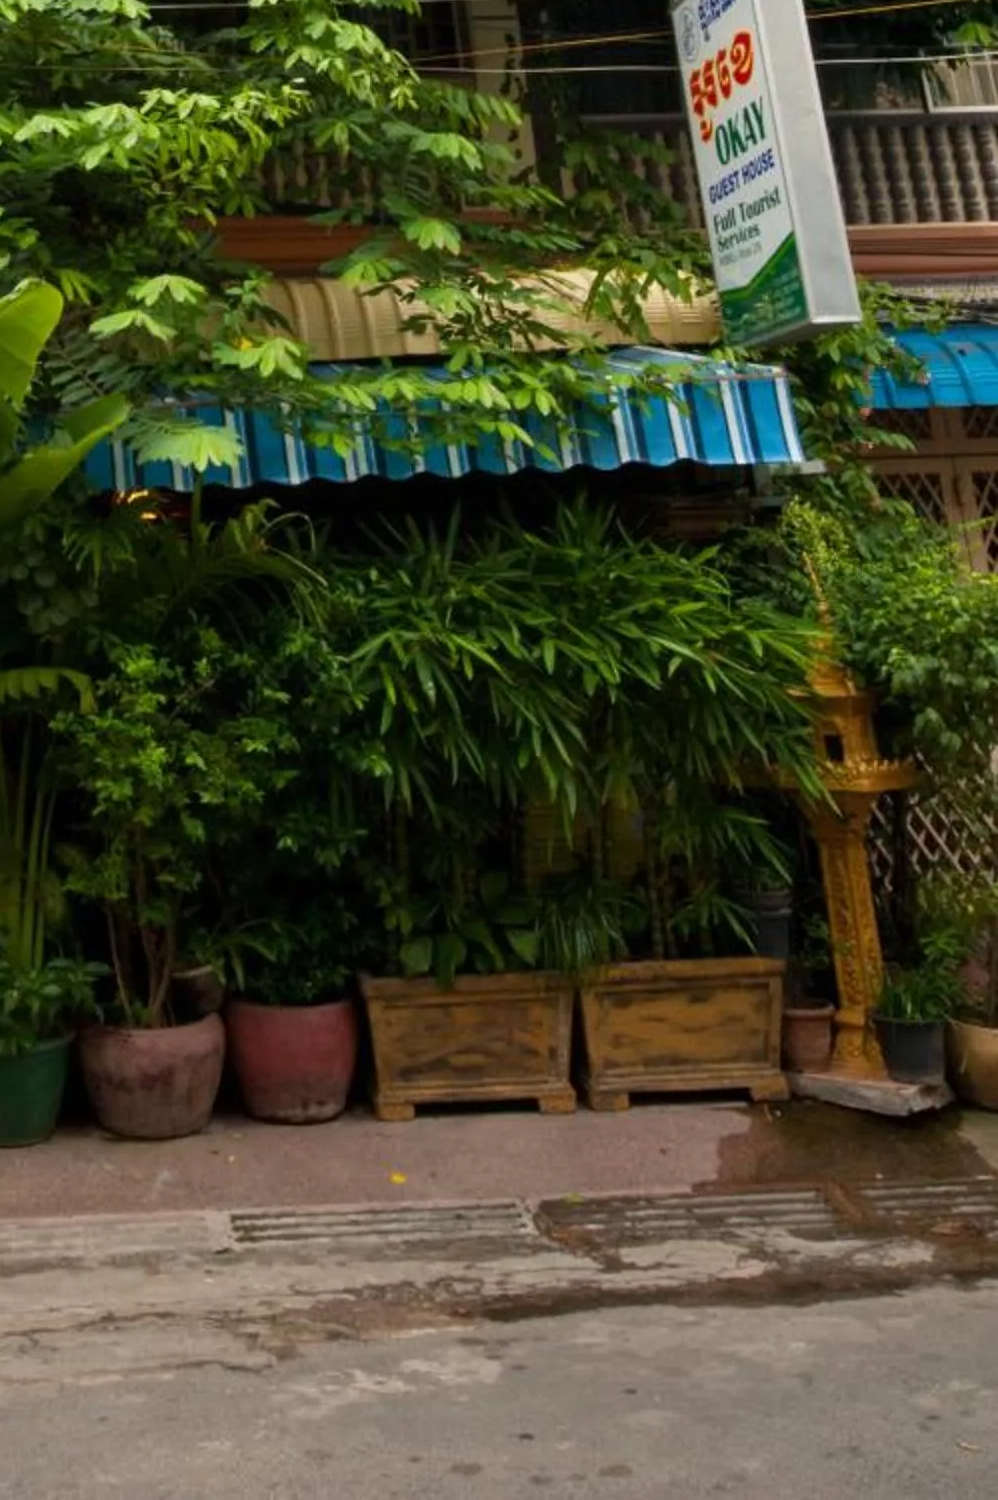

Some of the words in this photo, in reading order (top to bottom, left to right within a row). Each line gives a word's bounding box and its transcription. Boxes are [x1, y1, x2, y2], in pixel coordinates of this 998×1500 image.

[715, 95, 765, 165] OKAY
[709, 170, 740, 204] GUEST
[741, 148, 775, 185] HOUSE
[713, 207, 736, 234] Full
[738, 186, 781, 221] Tourist
[717, 223, 760, 253] Services
